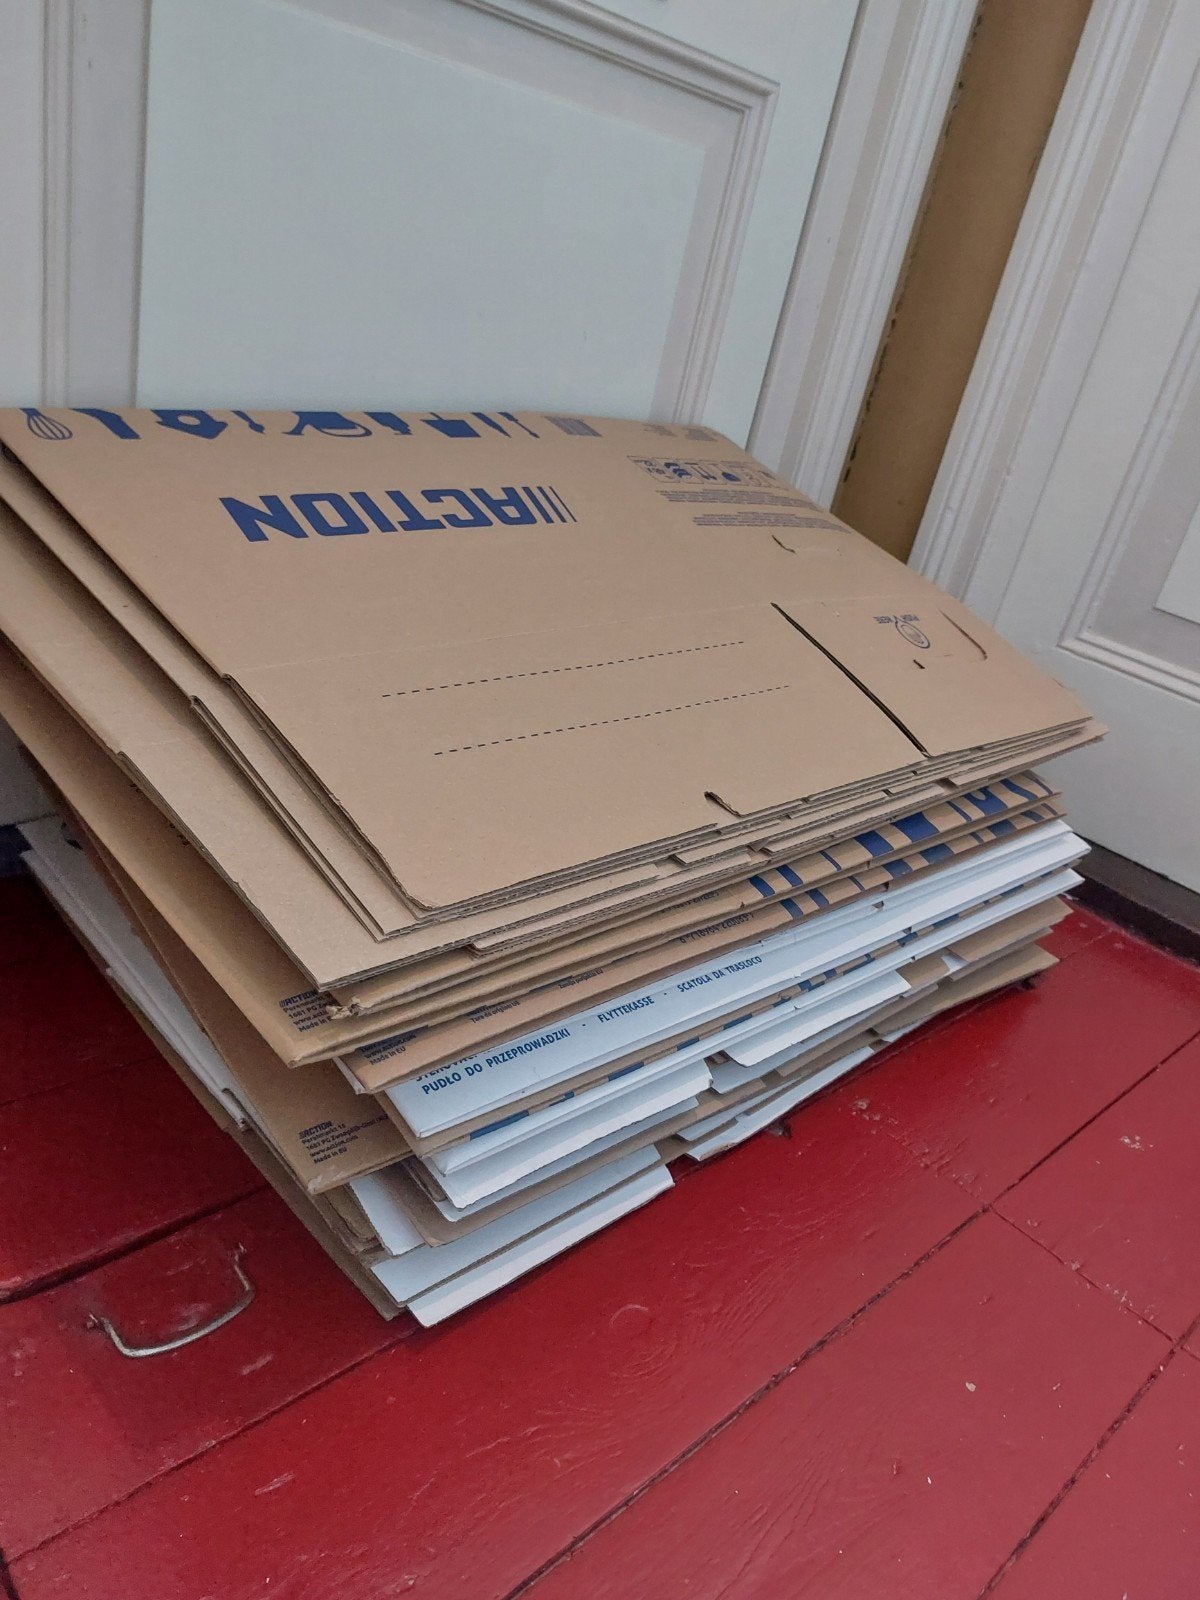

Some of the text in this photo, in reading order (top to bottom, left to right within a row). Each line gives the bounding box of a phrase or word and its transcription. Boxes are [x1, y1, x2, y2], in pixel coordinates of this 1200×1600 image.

[219, 486, 545, 542] ACTION
[279, 990, 319, 1007] ACTION
[299, 1021, 315, 1032] Made
[422, 1072, 462, 1094] PUDŁO
[464, 1063, 483, 1077] DO
[485, 1028, 571, 1068] PRZEPROWADZKI
[597, 996, 655, 1023] FLYTTEKASSE
[677, 974, 712, 993] SCATOLA
[712, 969, 725, 979] DA
[725, 956, 763, 974] TRASLOCO
[369, 1053, 388, 1065] Made
[395, 1046, 406, 1056] EU
[299, 1120, 332, 1139] ACTION
[313, 1153, 331, 1164] Made
[338, 1146, 347, 1155] EU
